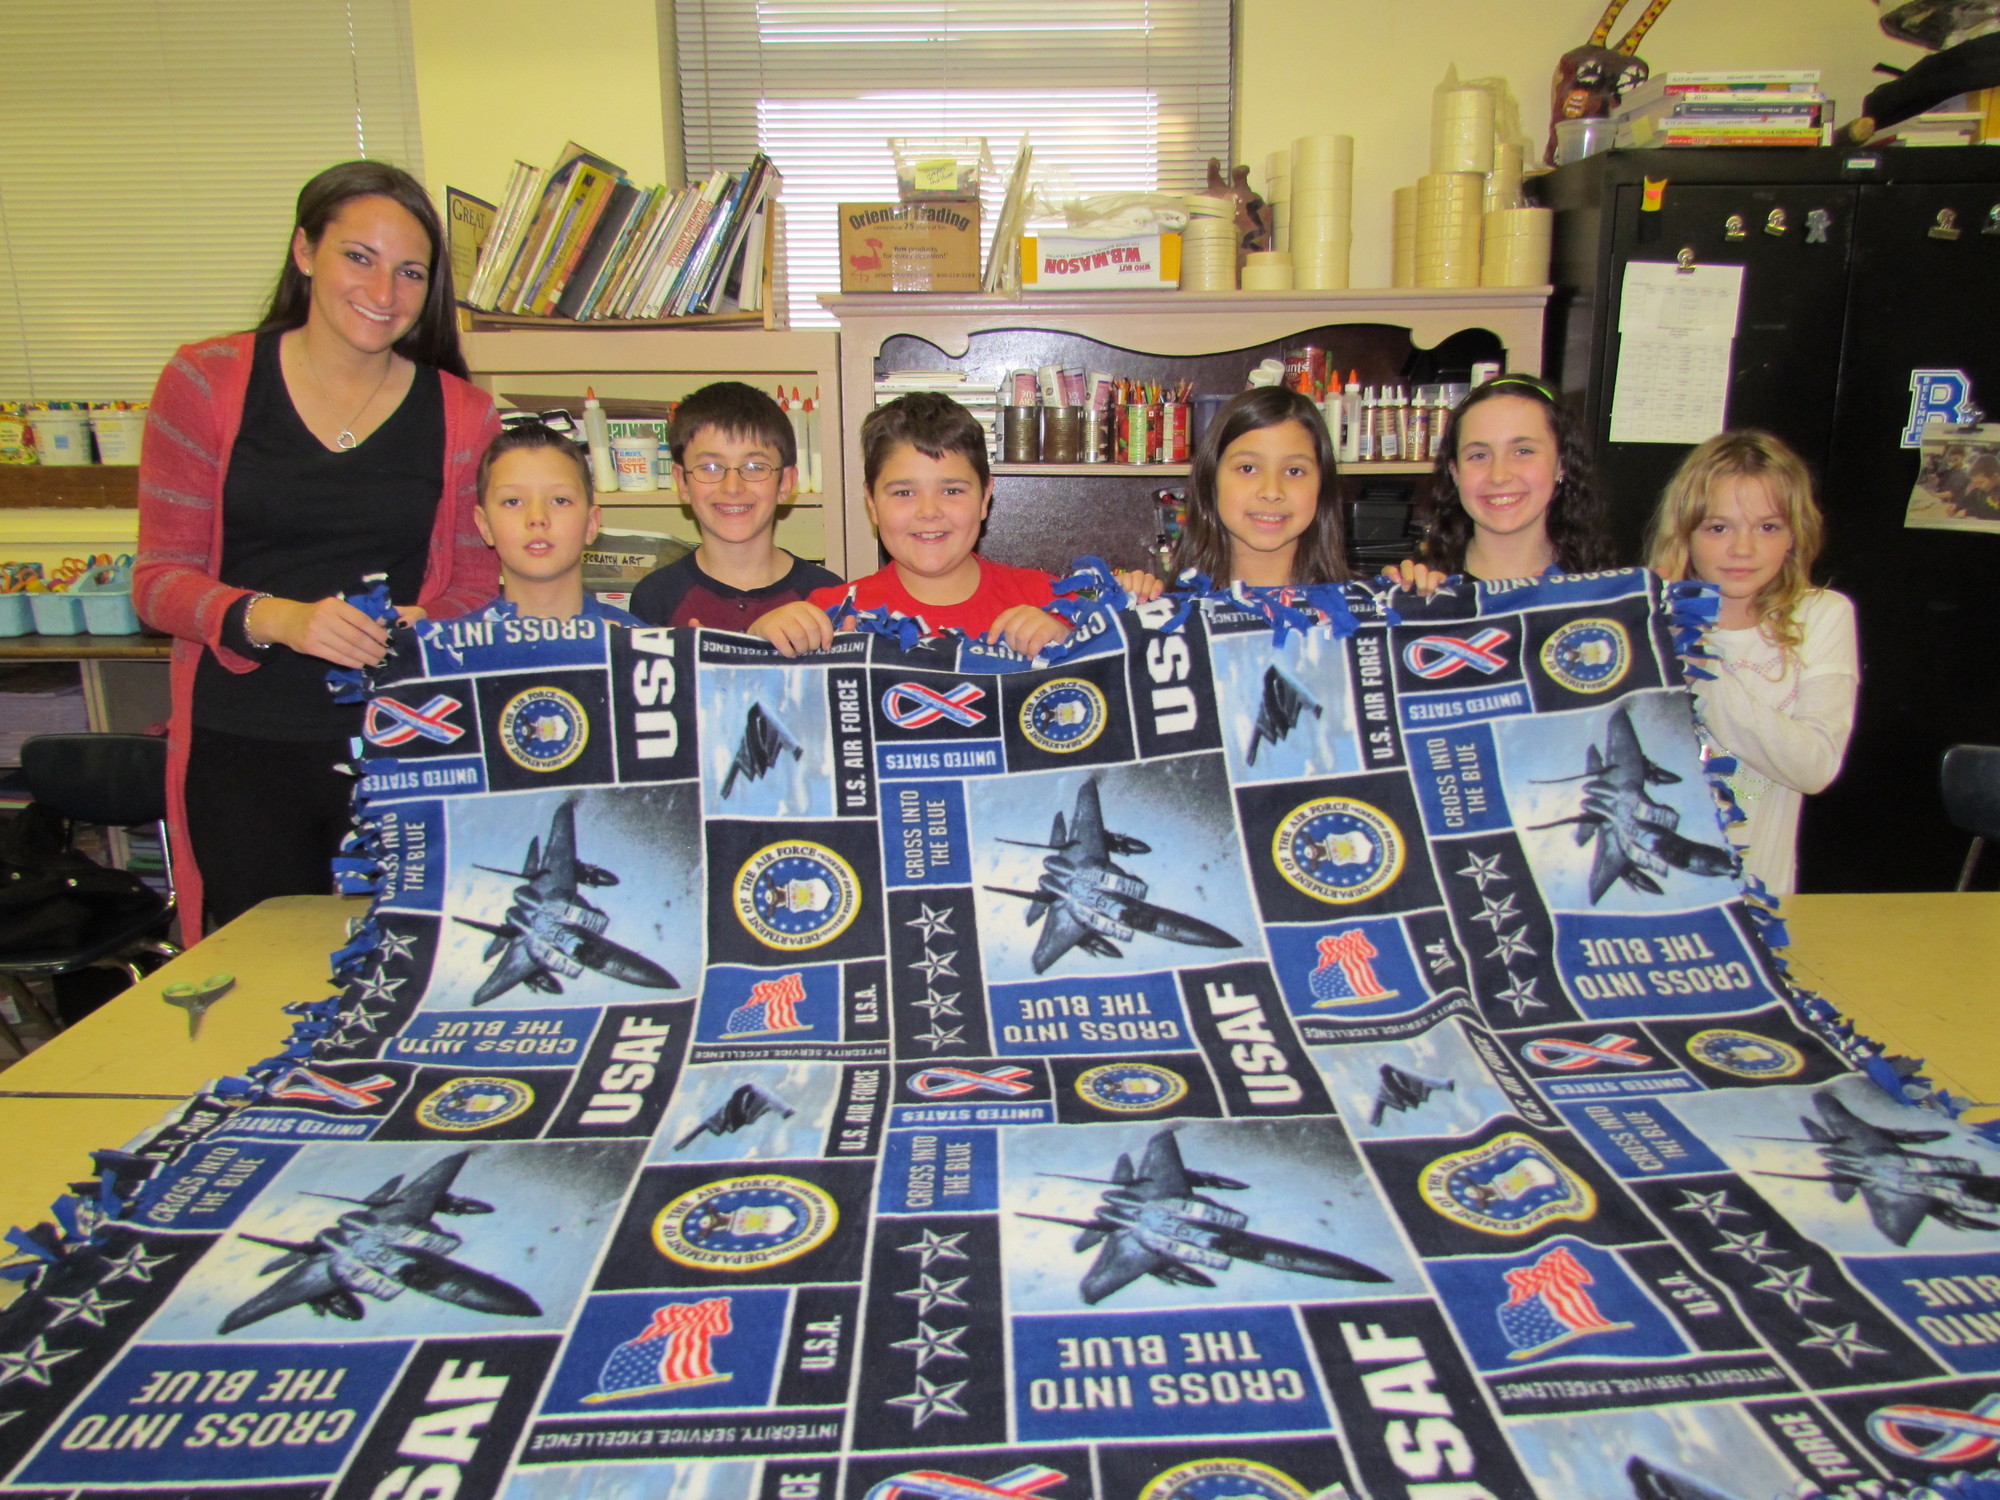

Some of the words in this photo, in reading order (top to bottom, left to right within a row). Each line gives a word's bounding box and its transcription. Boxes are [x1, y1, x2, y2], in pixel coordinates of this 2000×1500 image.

[453, 199, 487, 230] GREAT
[849, 206, 909, 231] Oriental
[912, 204, 971, 232] Trading
[903, 222, 915, 231] 75
[908, 246, 938, 254] products
[1118, 264, 1134, 273] BUT
[1134, 263, 1152, 272] WHO
[617, 463, 648, 475] ASTE
[583, 553, 618, 565] SCRATCH
[622, 555, 645, 566] ART
[504, 618, 597, 643] CROSS
[1356, 636, 1382, 688] FORCE
[527, 690, 557, 701] FORCE
[1049, 682, 1078, 691] FORCE
[836, 678, 860, 732] FORCE
[1364, 691, 1387, 726] AIR
[1408, 701, 1464, 720] STATES
[1467, 691, 1523, 712] UNITED
[842, 736, 864, 769] AIR
[1370, 728, 1395, 761] U.S.
[1426, 737, 1455, 774] INTO
[885, 752, 941, 771] STATES
[943, 749, 998, 769] UNITED
[1454, 742, 1484, 783] BLUE
[362, 770, 421, 792] STATES
[427, 766, 479, 787] UNITED
[845, 773, 868, 808] U.S.
[1437, 775, 1465, 829] CROSS
[1467, 784, 1488, 815] THE
[899, 789, 922, 825] INTO
[925, 798, 950, 837] BLUE
[1288, 811, 1310, 829] AIR
[1308, 802, 1350, 815] FORCE
[404, 821, 426, 860] BLUE
[776, 845, 818, 857] FORCE
[905, 828, 926, 880] CROSS
[930, 839, 951, 867] THE
[1279, 830, 1292, 851] THE
[754, 852, 775, 870] AIR
[1279, 856, 1295, 871] OF
[403, 863, 426, 892] THE
[740, 869, 757, 892] THE
[1290, 872, 1370, 899] DEPARTMENT
[740, 897, 754, 914] OF
[747, 916, 821, 946] DEPARTMENT
[1578, 937, 1655, 968] BLUE
[1653, 932, 1715, 963] THE
[1573, 971, 1648, 1001] INTO
[1648, 960, 1753, 997] CROSS
[854, 983, 878, 1025] U.S.A.
[1018, 995, 1092, 1020] BLUE
[1100, 991, 1153, 1016] THE
[435, 1021, 505, 1038] BLUE
[510, 1019, 566, 1036] THE
[1003, 1022, 1070, 1043] INTO
[1081, 1019, 1180, 1042] CROSS
[397, 1036, 469, 1055] INTO
[474, 1036, 579, 1055] CROSS
[694, 1050, 773, 1060] EXCELLENCE
[1203, 982, 1304, 1106] USAF
[578, 1016, 672, 1126] USAF
[1619, 1077, 1692, 1092] UNITED
[852, 1067, 880, 1103] FORCE
[1550, 1080, 1621, 1095] STATES
[845, 1105, 875, 1129] AIR
[901, 1108, 972, 1123] STATES
[975, 1106, 1045, 1121] UNITED
[1584, 1105, 1627, 1130] INTO
[1621, 1109, 1669, 1139] BLUE
[295, 1119, 369, 1136] UNITED
[838, 1130, 871, 1152] U.S.
[911, 1134, 939, 1162] INTO
[943, 1141, 973, 1172] BLUE
[1608, 1131, 1666, 1172] CROSS
[1650, 1138, 1690, 1160] THE
[146, 1175, 208, 1224] CROSS
[191, 1146, 241, 1175] INTO
[188, 1190, 233, 1215] THE
[213, 1157, 267, 1188] BLUE
[730, 1178, 788, 1190] FORCE
[905, 1163, 937, 1209] CROSS
[942, 1173, 971, 1198] THE
[1427, 1173, 1444, 1192] THE
[1437, 1159, 1459, 1173] AIR
[696, 1185, 723, 1201] AIR
[668, 1200, 695, 1220] THE
[661, 1223, 678, 1238] OF
[666, 1238, 769, 1265] DEPARTMENT
[1657, 1269, 1723, 1317] U.S.A.
[800, 1314, 844, 1371] U.S.A.
[1057, 1334, 1169, 1369] BLUE
[1178, 1330, 1262, 1364] THE
[129, 1369, 260, 1405] BLUE
[257, 1367, 348, 1402] THE
[1029, 1375, 1135, 1412] INTO
[1149, 1368, 1306, 1407] CROSS
[1495, 1378, 1616, 1401] EXCELLENCE
[1338, 1321, 1500, 1500] SAF
[60, 1412, 185, 1451] INTO
[183, 1408, 358, 1448] CROSS
[368, 1358, 511, 1500] SAF
[530, 1430, 653, 1450] EXCELLENCE
[1770, 1411, 1864, 1480] FORCE
